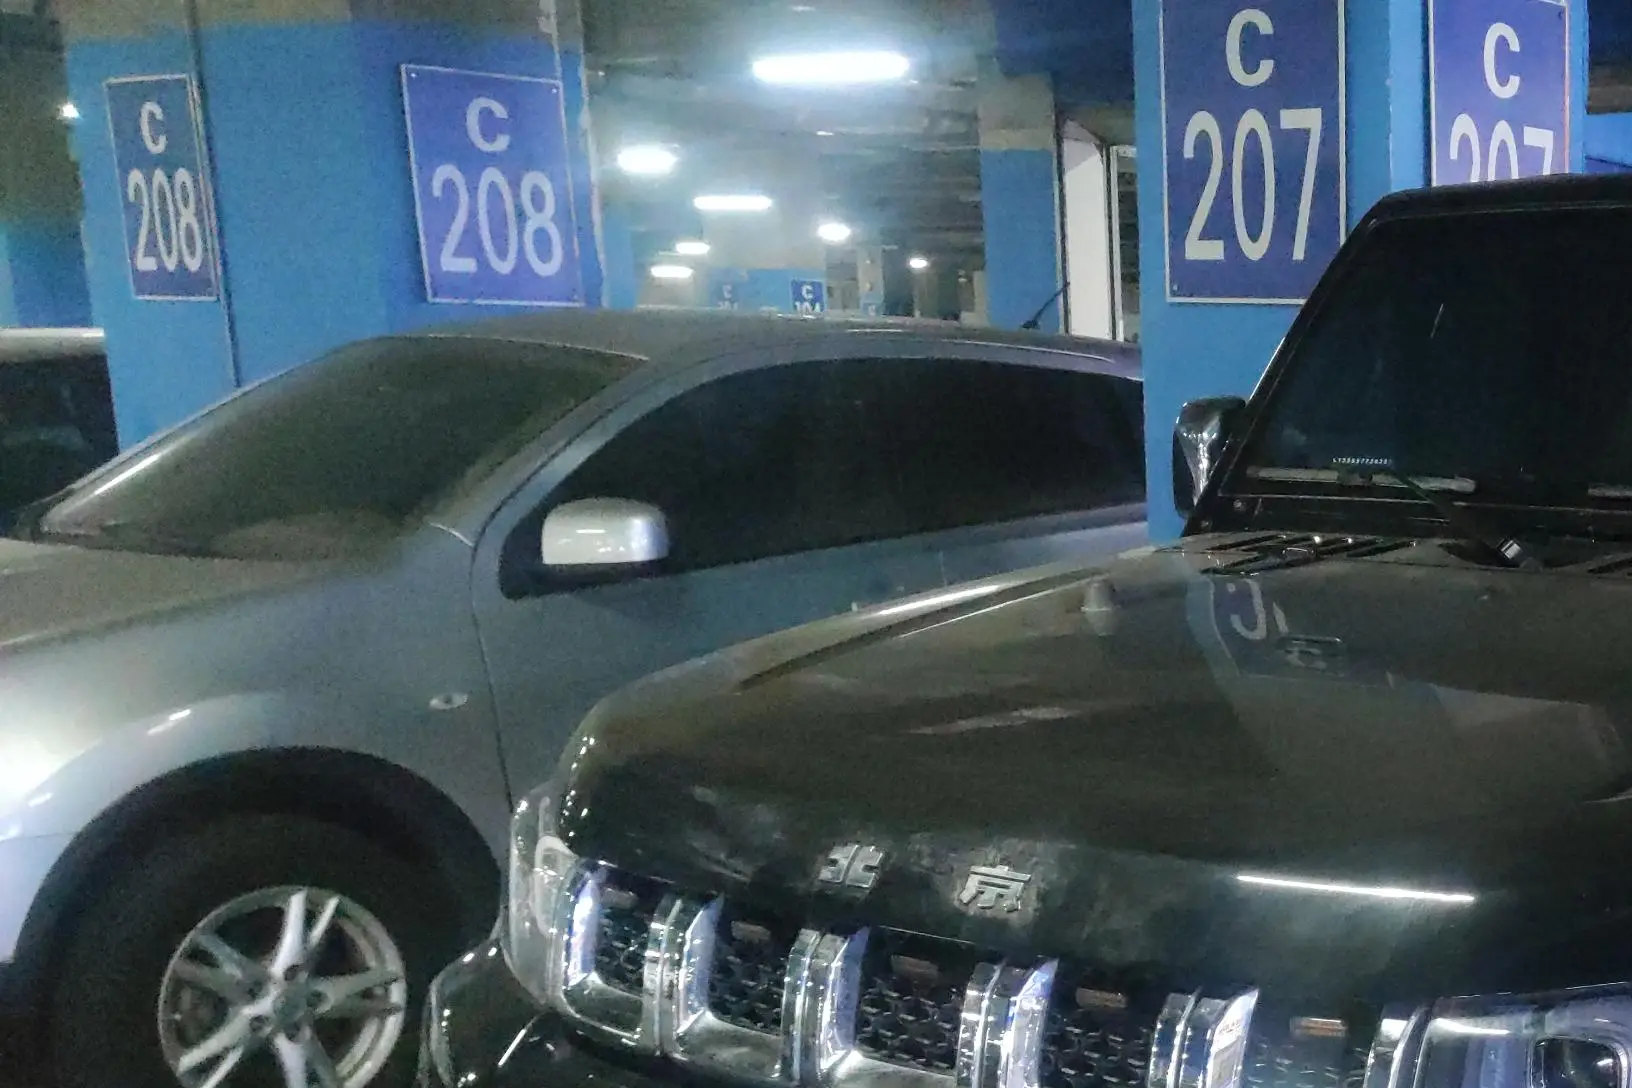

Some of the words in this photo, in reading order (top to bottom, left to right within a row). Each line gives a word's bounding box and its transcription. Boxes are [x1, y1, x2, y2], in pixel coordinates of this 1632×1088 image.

[1226, 8, 1274, 87] C
[1484, 22, 1520, 99] C
[140, 101, 167, 154] C
[466, 97, 509, 153] C
[127, 167, 202, 272] 208
[432, 164, 563, 276] 208
[1183, 107, 1322, 261] 207
[801, 285, 813, 299] C
